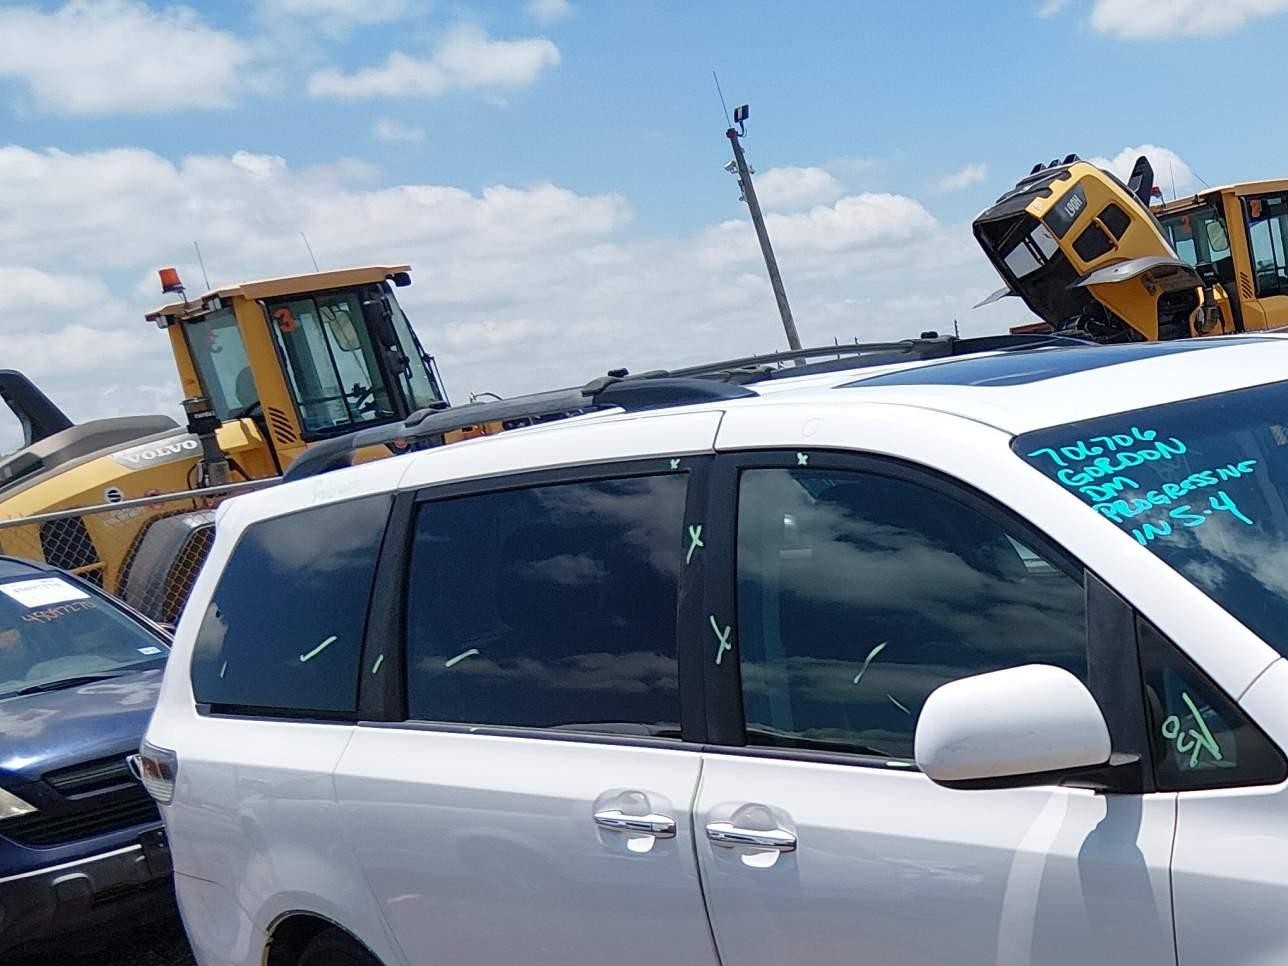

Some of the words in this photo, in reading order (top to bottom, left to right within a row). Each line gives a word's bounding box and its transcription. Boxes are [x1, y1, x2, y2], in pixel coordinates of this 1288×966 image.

[274, 307, 296, 333] 3
[127, 439, 197, 463] VOLVO
[1027, 426, 1157, 466] 706706
[1057, 437, 1187, 487] GORDON
[1079, 476, 1139, 502] DM
[1132, 519, 1173, 546] IN
